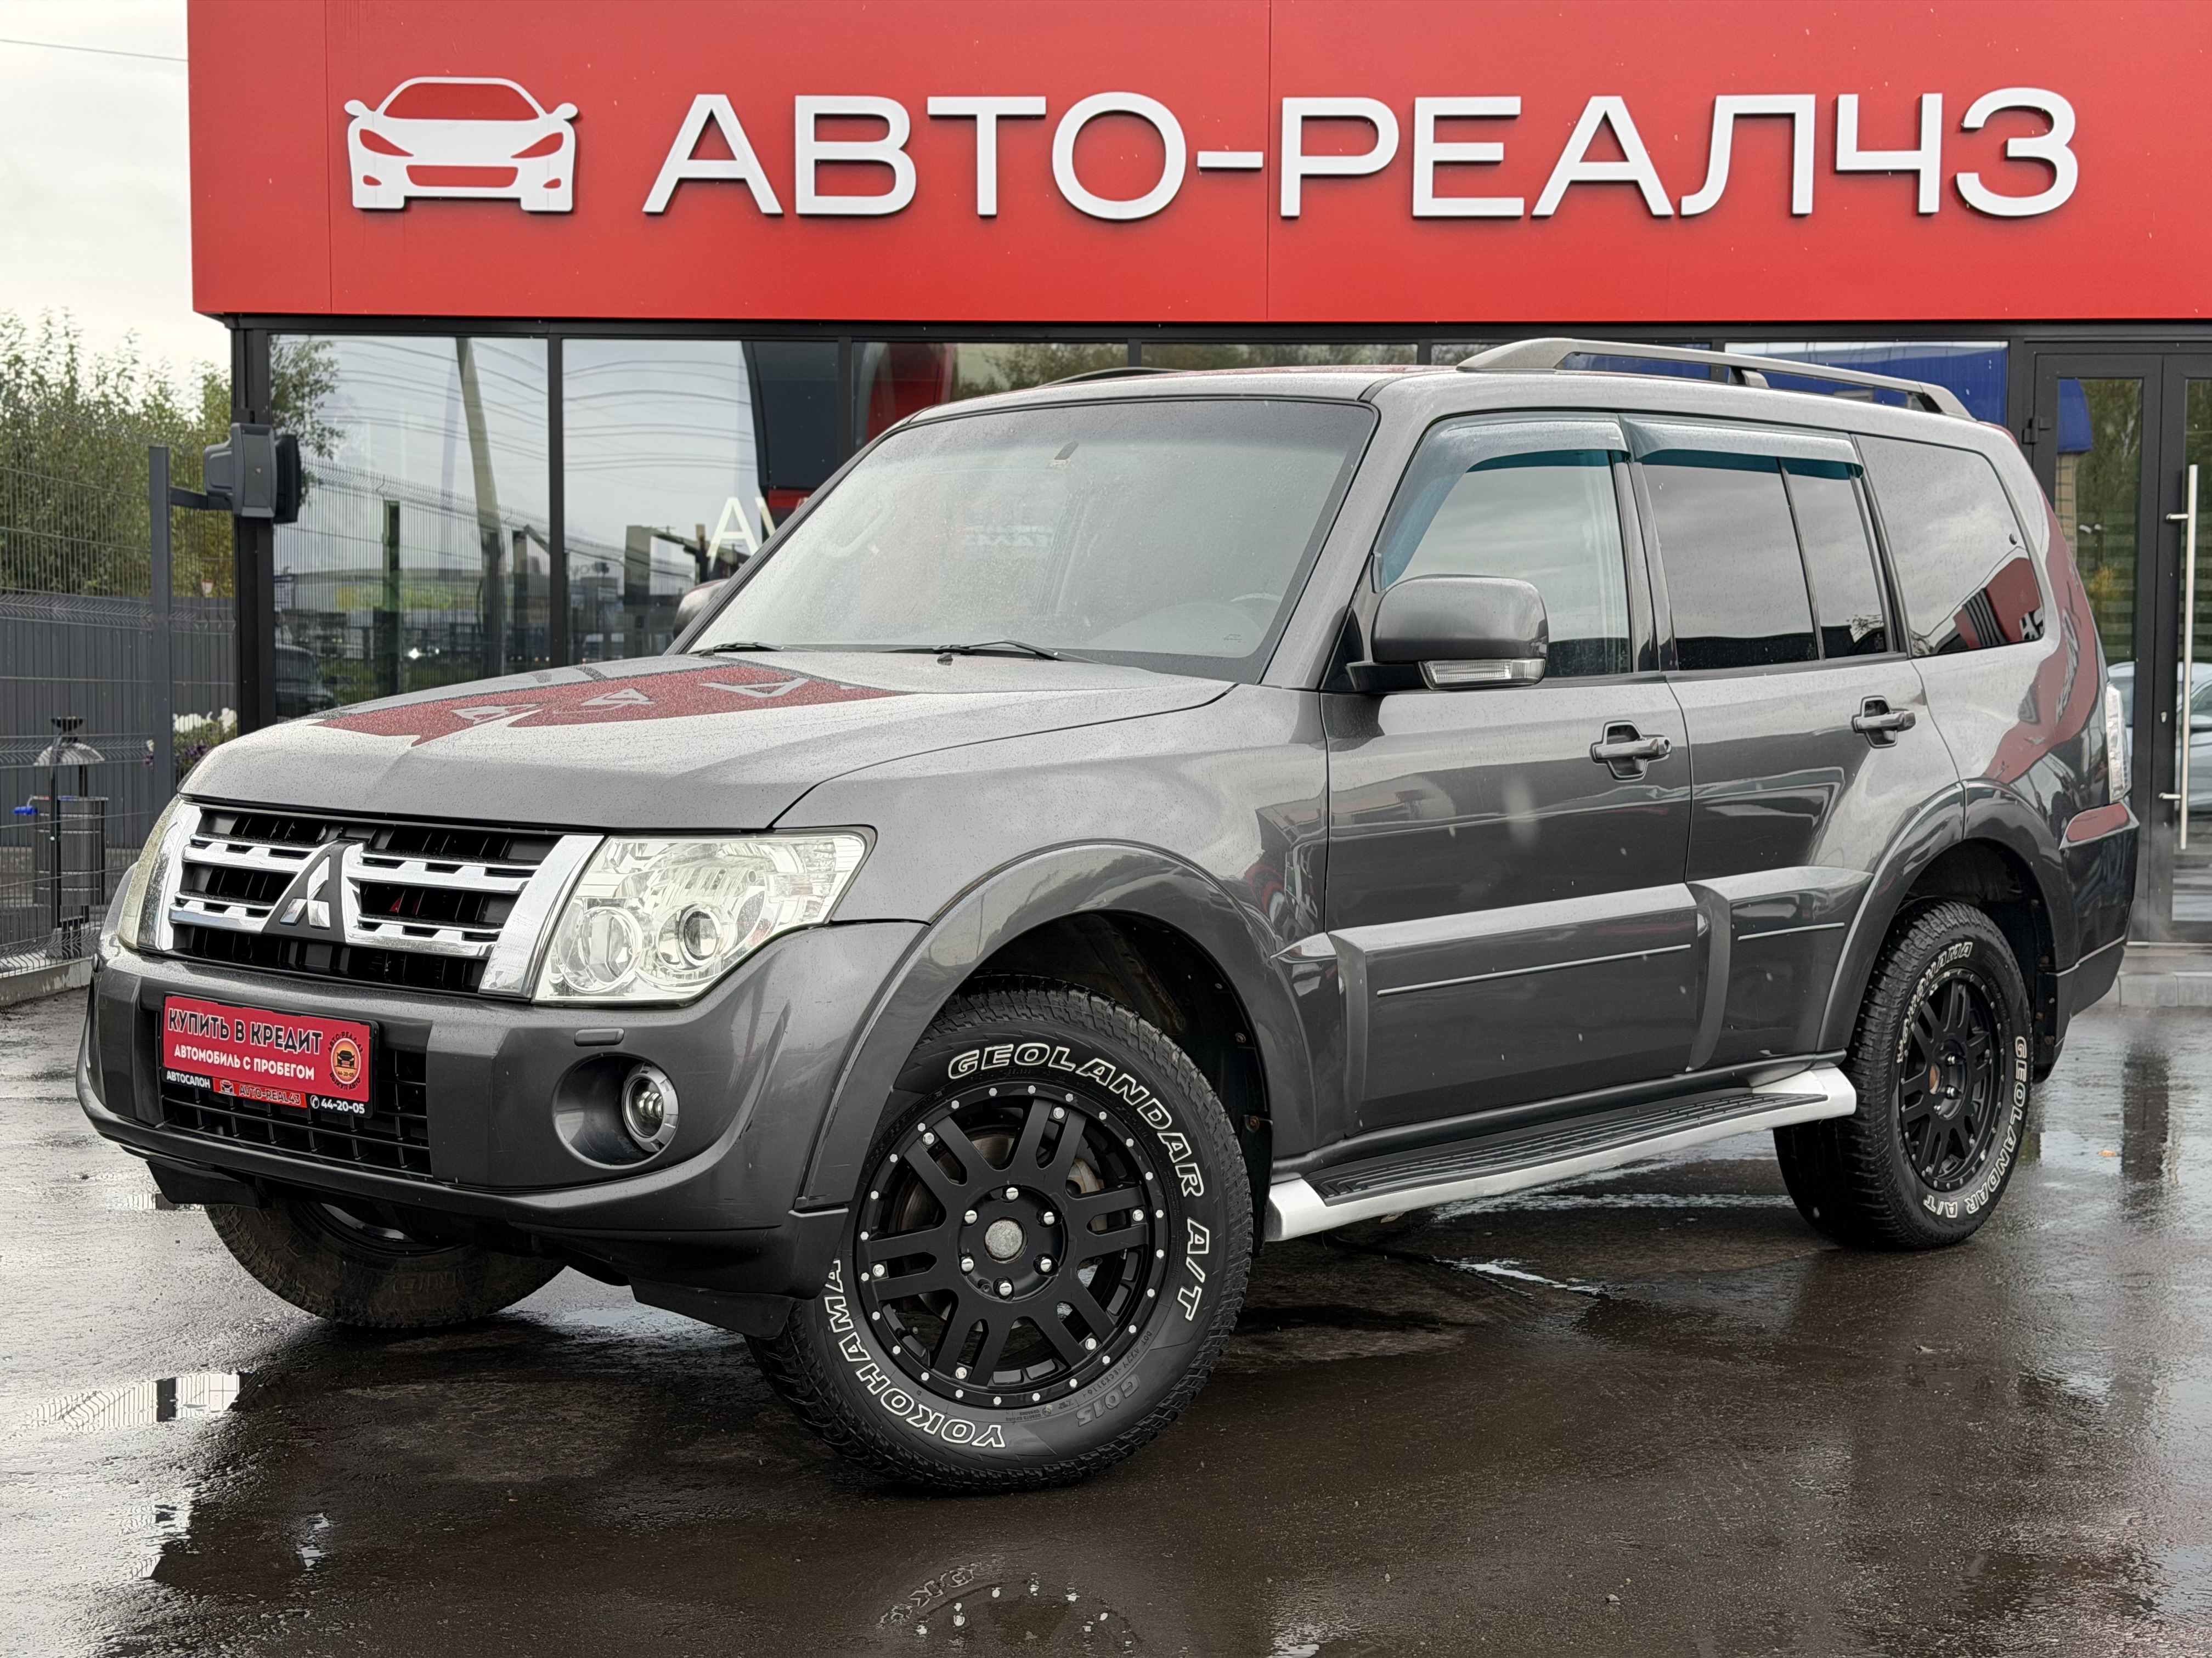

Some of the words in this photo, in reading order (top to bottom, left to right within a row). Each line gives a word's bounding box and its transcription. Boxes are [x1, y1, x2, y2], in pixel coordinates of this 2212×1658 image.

[168, 1008, 230, 1040] КУПИТЬ
[234, 1019, 246, 1043] В
[250, 1022, 323, 1055] КРЕДИТ
[166, 1070, 211, 1089] АВТОСАЛОН
[174, 1044, 241, 1068] АВТОМОБИЛЬ
[242, 1056, 251, 1070] С
[253, 1059, 315, 1080] ПРОБЕГОМ
[239, 1084, 301, 1106] AVTO-REAL43
[321, 1097, 365, 1114] 44-20-05
[1966, 1037, 2027, 1215] GEOLANDAR
[948, 1043, 1205, 1197] GEOLANDAR
[1177, 1216, 1209, 1321] A/T
[1923, 1193, 1957, 1218] A/T
[823, 1258, 1005, 1448] YOKOHAMA
[1141, 1331, 1153, 1345] DOT
[1075, 1373, 1140, 1427] G015
